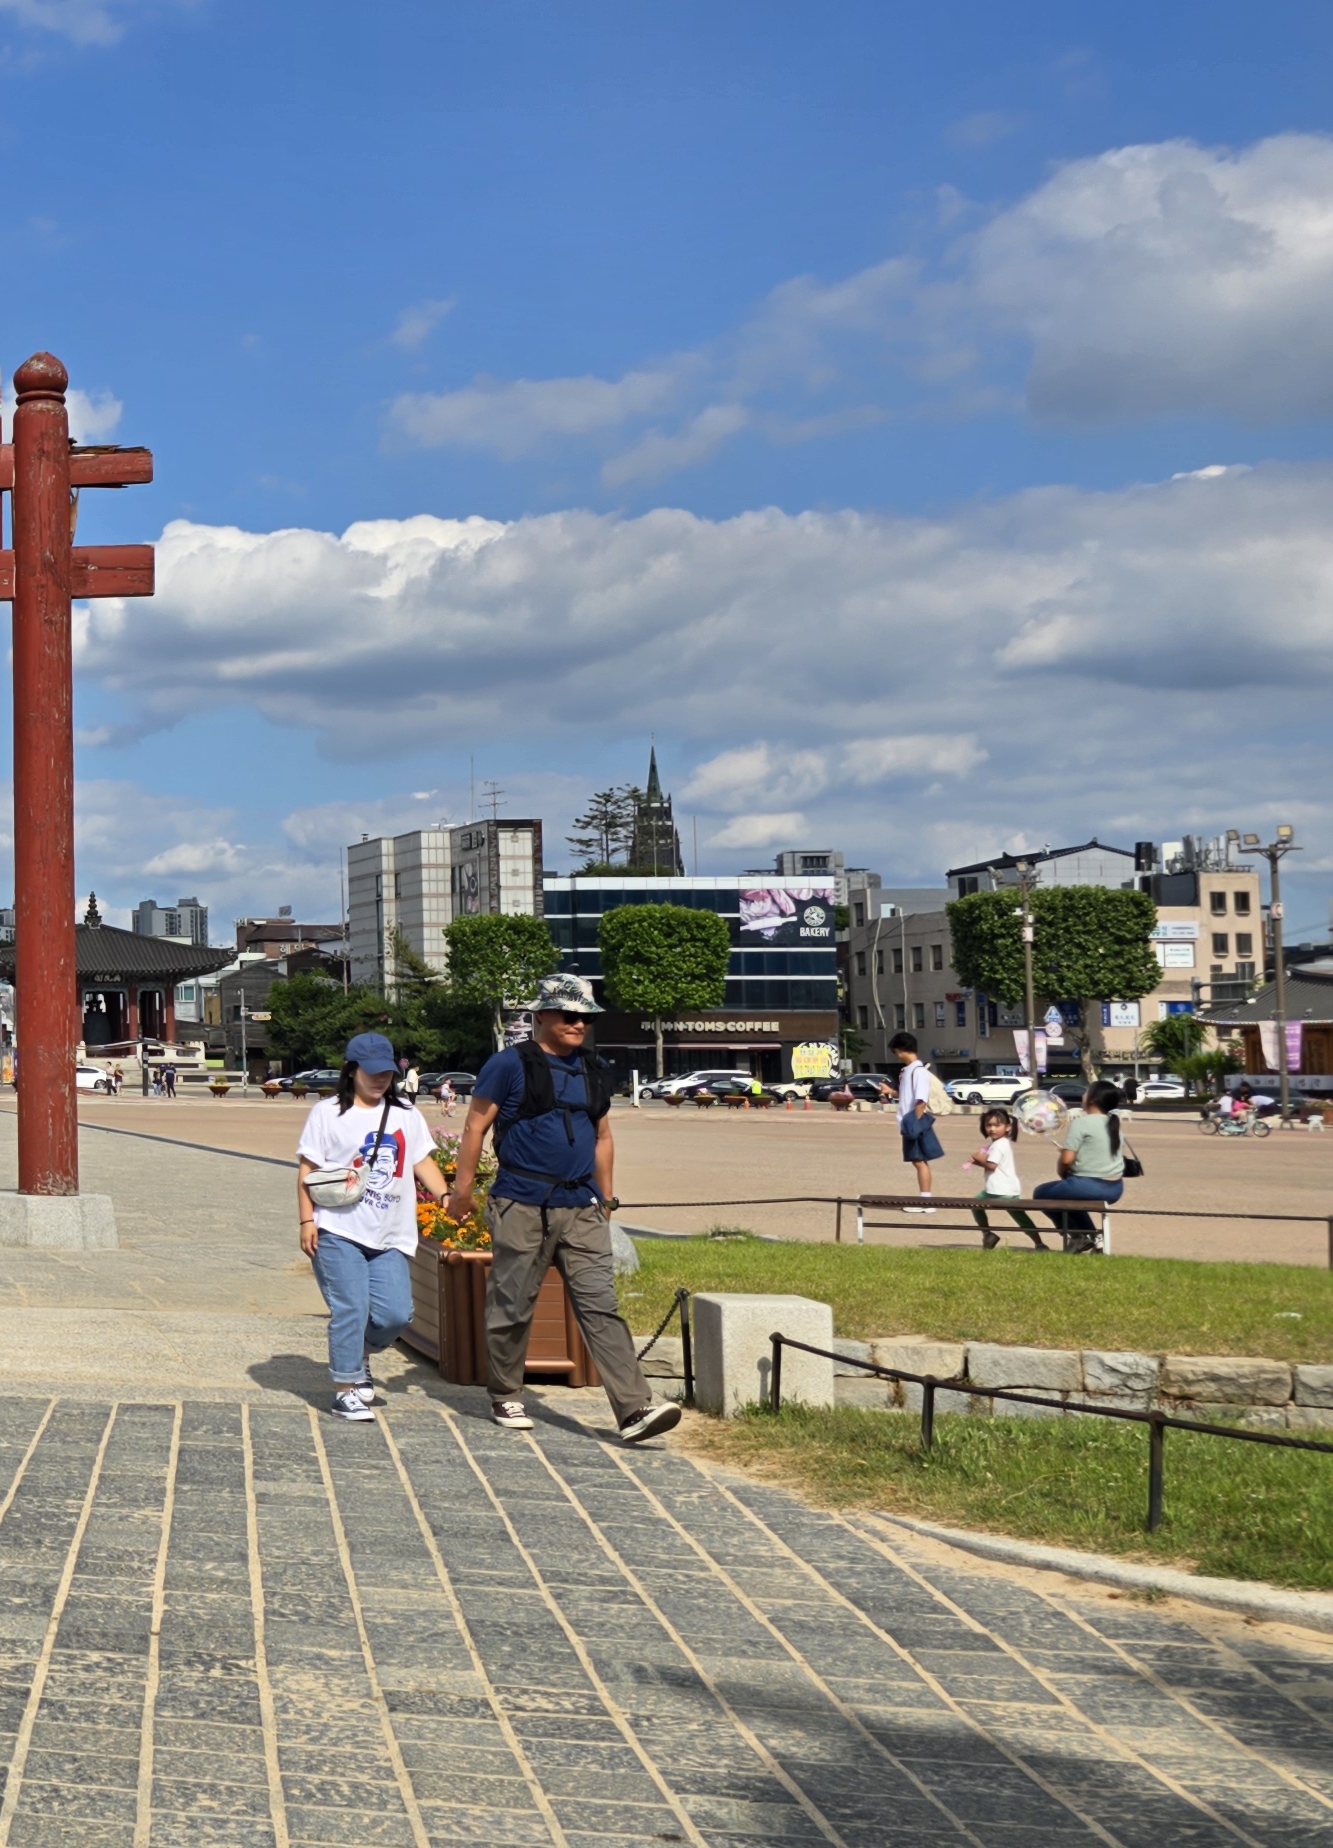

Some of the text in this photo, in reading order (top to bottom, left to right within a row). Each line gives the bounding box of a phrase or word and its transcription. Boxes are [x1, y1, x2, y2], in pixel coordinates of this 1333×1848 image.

[799, 926, 830, 937] BAKERY
[726, 1021, 780, 1032] COFFEE
[1048, 1026, 1059, 1034] 50
